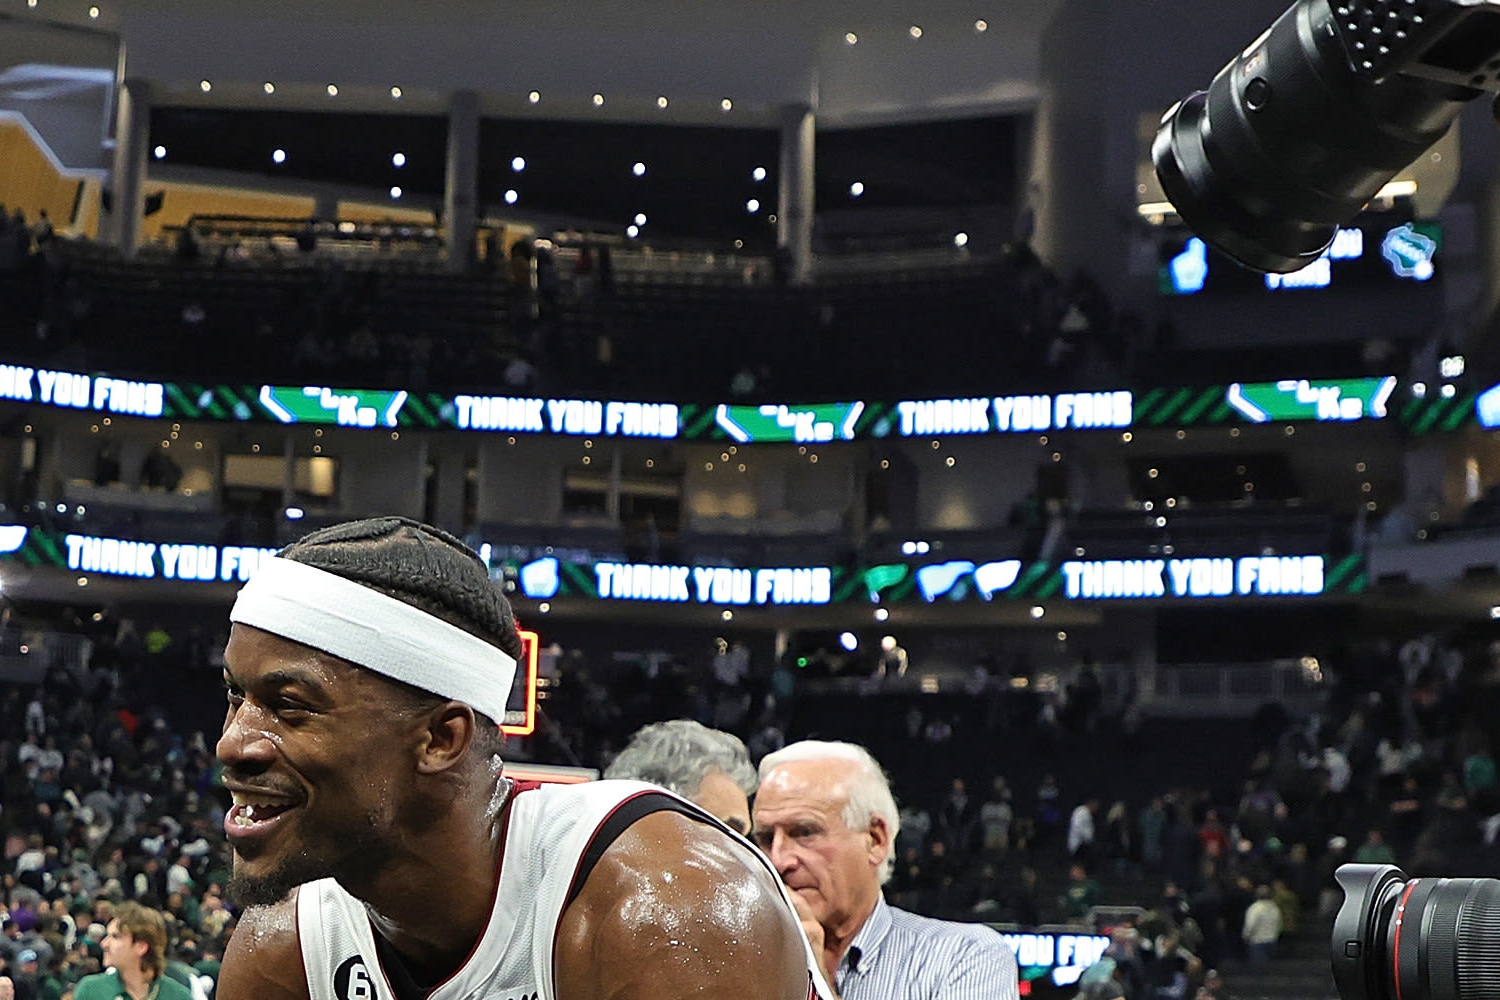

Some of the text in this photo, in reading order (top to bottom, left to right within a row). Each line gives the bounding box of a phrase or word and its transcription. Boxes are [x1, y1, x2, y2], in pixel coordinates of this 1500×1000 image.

[37, 369, 91, 408] YOU
[93, 376, 164, 416] FANS
[897, 390, 1133, 435] THANK YOU FANS
[454, 395, 679, 437] THANK YOU FANS
[65, 534, 156, 577] THANK
[159, 543, 218, 580] YOU
[1063, 555, 1324, 598] THANK YOU FANS
[595, 562, 831, 604] THANK YOU FANS
[1057, 935, 1111, 967] FAN
